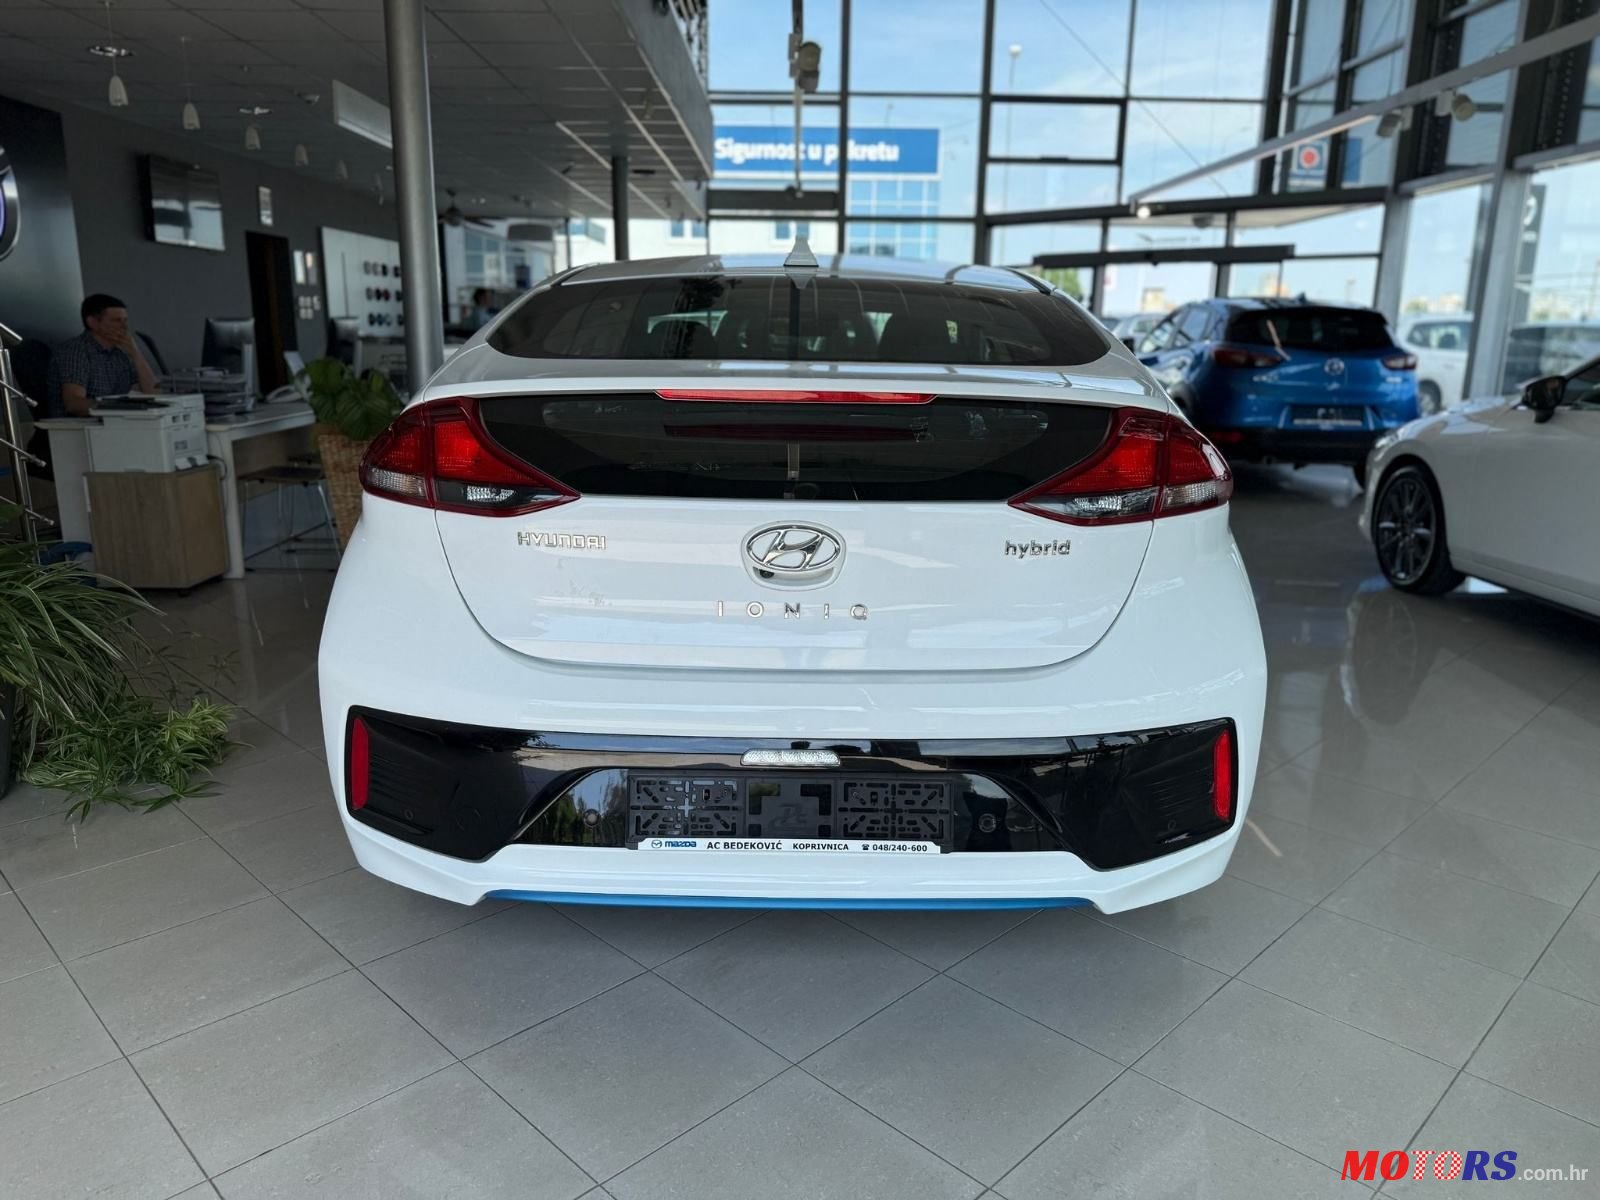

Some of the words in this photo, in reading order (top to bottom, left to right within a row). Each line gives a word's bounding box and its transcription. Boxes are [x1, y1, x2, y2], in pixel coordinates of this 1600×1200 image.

[808, 143, 822, 160] u
[824, 139, 899, 165] pkretu
[517, 531, 606, 549] HYUNDAI
[1005, 540, 1071, 559] hybrid
[717, 601, 868, 620] IONIQ
[707, 842, 721, 850] AC
[723, 840, 782, 850] BEDEKOVIĆ
[872, 844, 928, 852] 048/240-600
